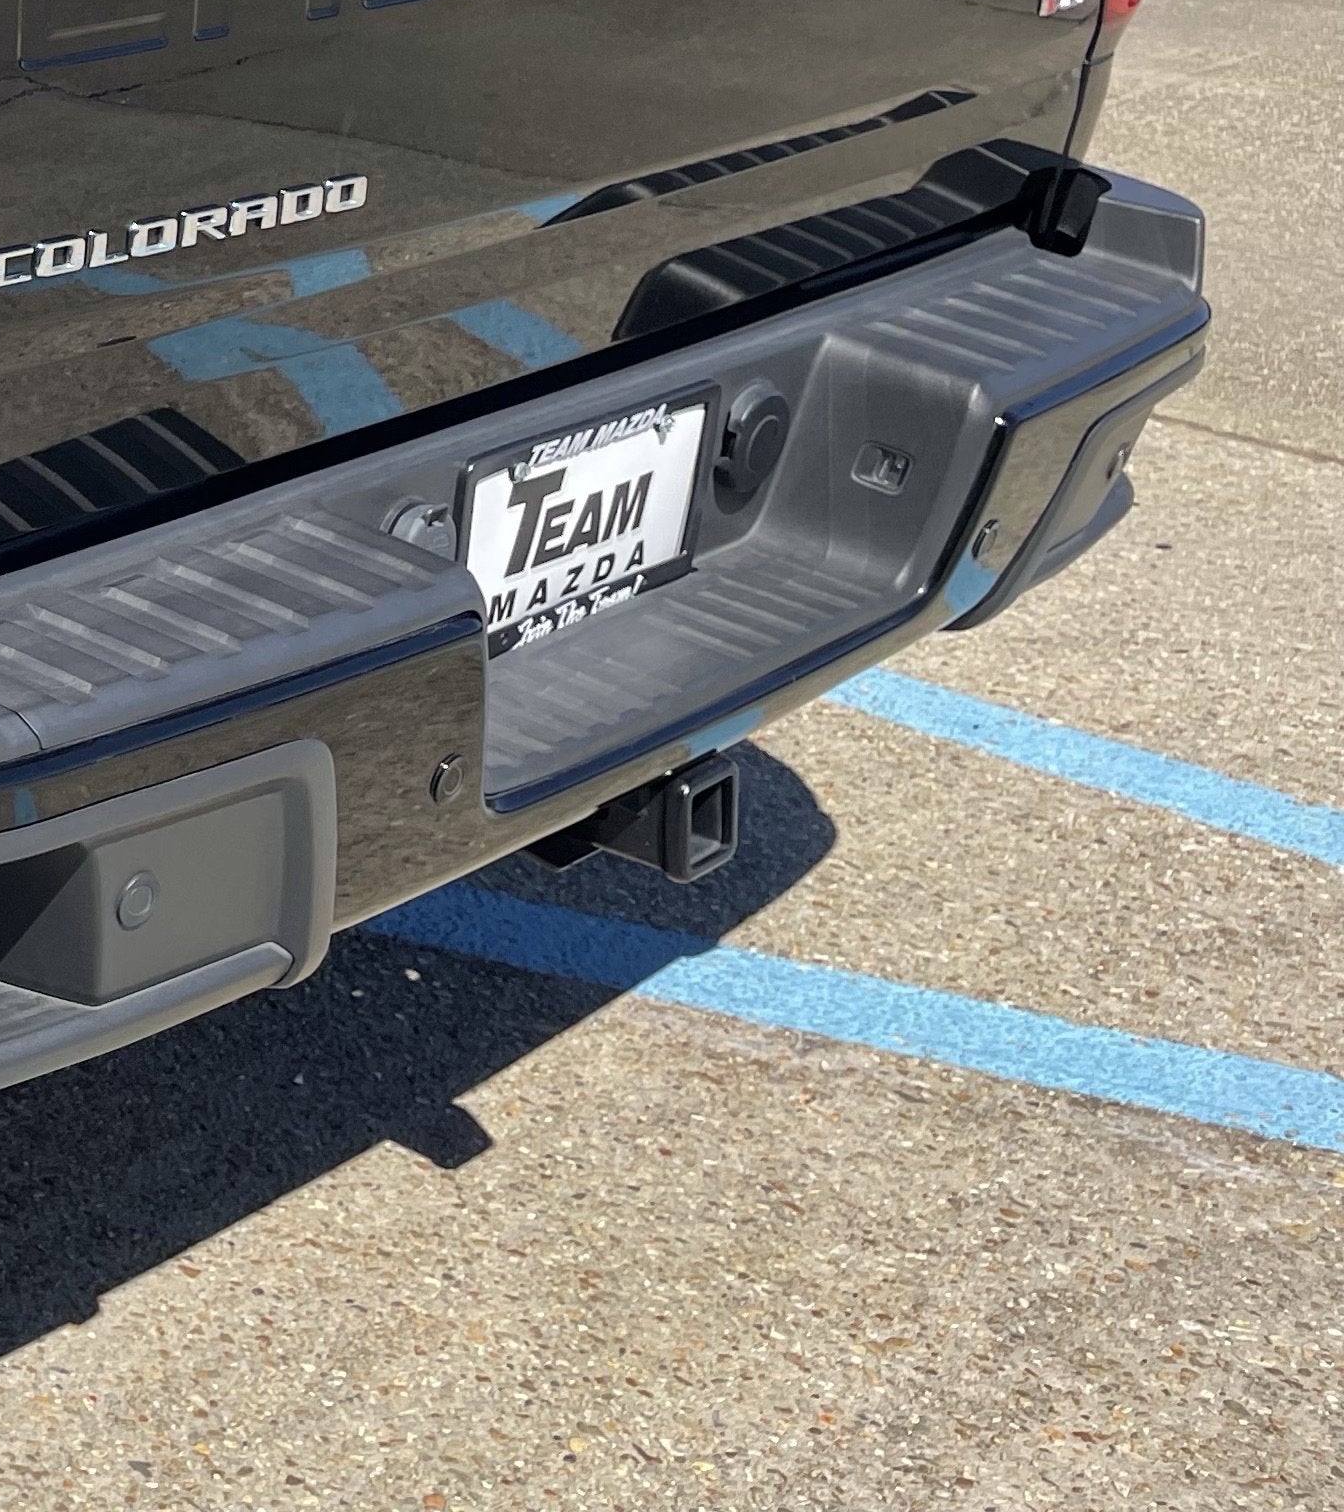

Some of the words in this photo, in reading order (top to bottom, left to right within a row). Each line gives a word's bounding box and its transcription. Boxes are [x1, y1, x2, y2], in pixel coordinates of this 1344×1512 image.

[528, 429, 593, 466] TEAM
[592, 403, 668, 449] MAZDA
[487, 540, 644, 625] MAZDA
[513, 615, 554, 651] Join
[554, 599, 586, 630] The
[589, 574, 644, 613] Team!
